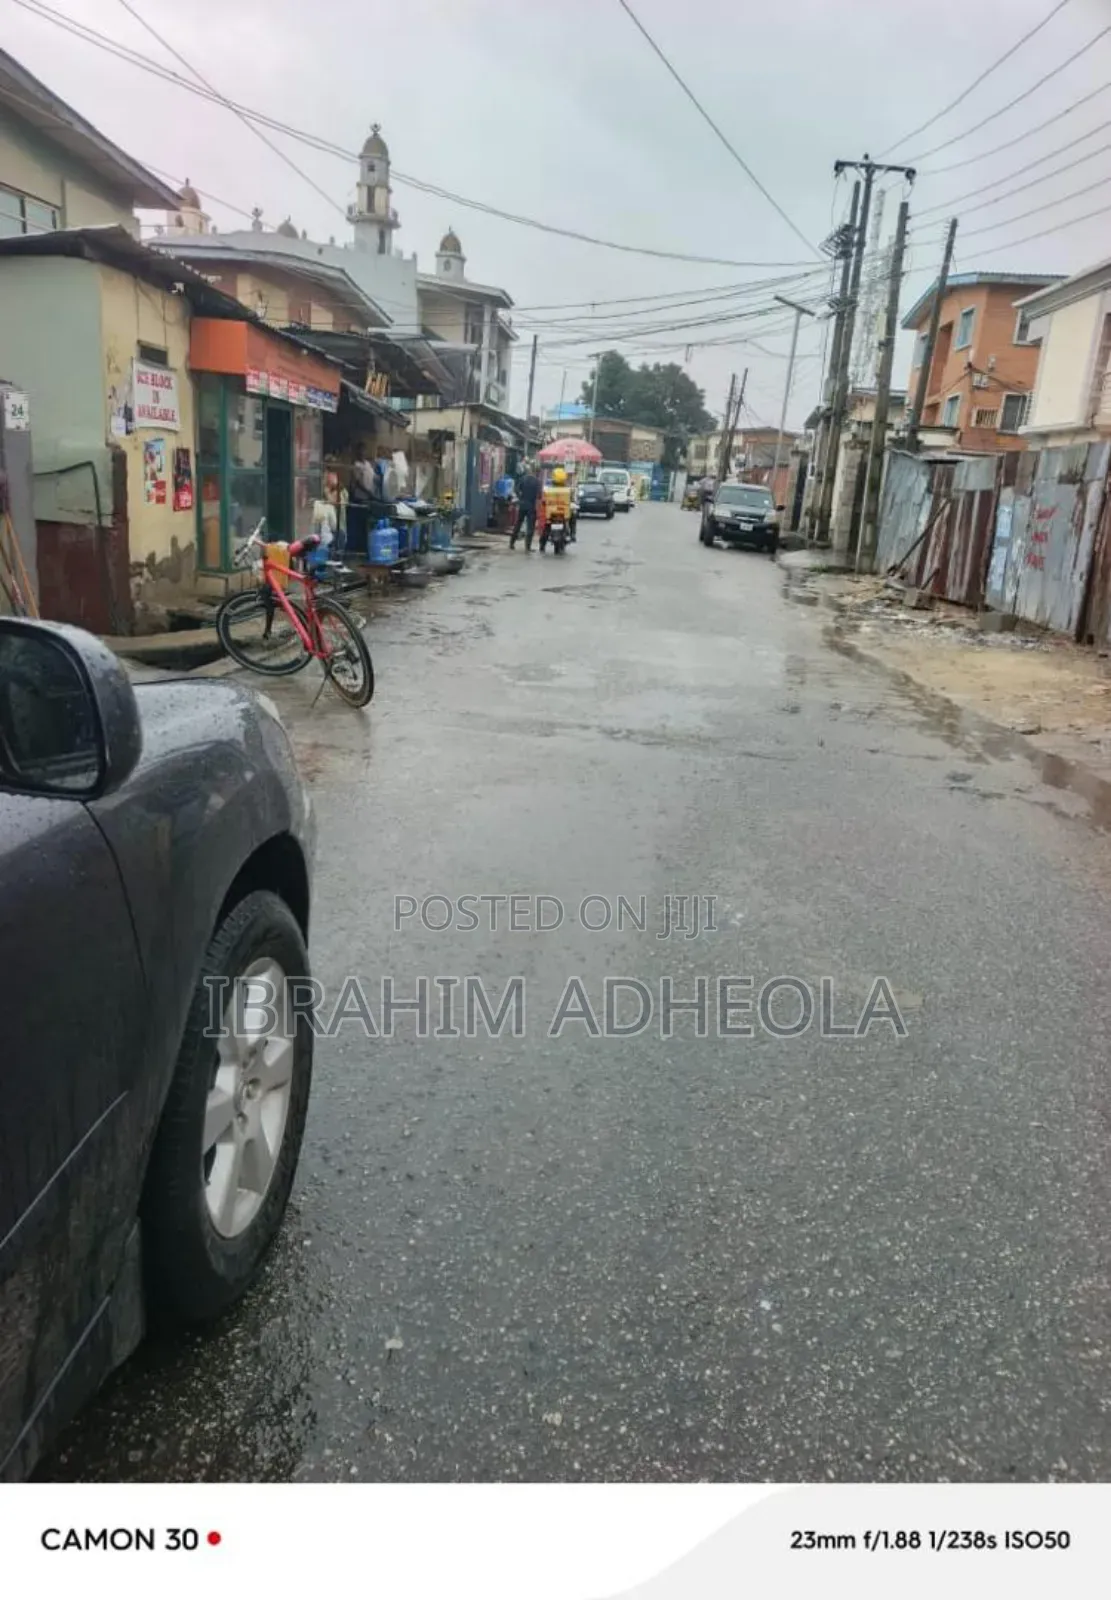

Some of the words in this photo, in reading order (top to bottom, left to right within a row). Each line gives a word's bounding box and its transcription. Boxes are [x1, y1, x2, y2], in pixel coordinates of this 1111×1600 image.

[151, 373, 173, 390] BLOCK
[11, 403, 24, 417] 24
[137, 405, 177, 423] AVAILABLE
